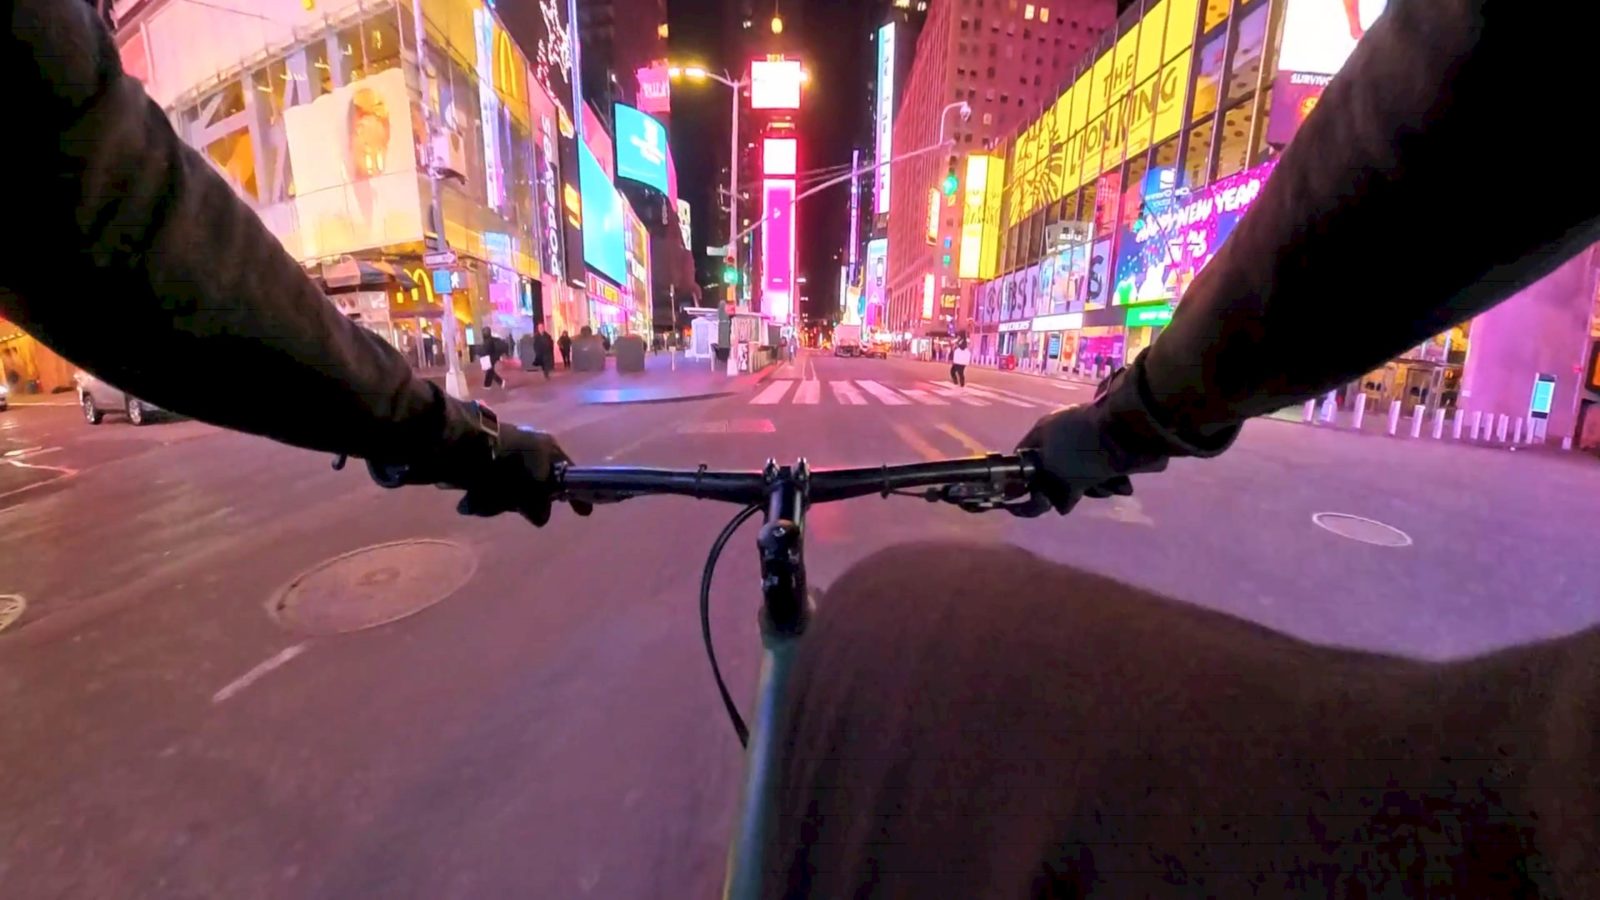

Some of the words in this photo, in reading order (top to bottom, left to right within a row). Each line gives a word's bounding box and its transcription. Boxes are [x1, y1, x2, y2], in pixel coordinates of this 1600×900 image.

[1104, 53, 1134, 98] THE
[1070, 112, 1114, 177] LION
[1114, 66, 1178, 149] KING
[1178, 197, 1214, 228] NEW
[1213, 178, 1261, 214] YEAR
